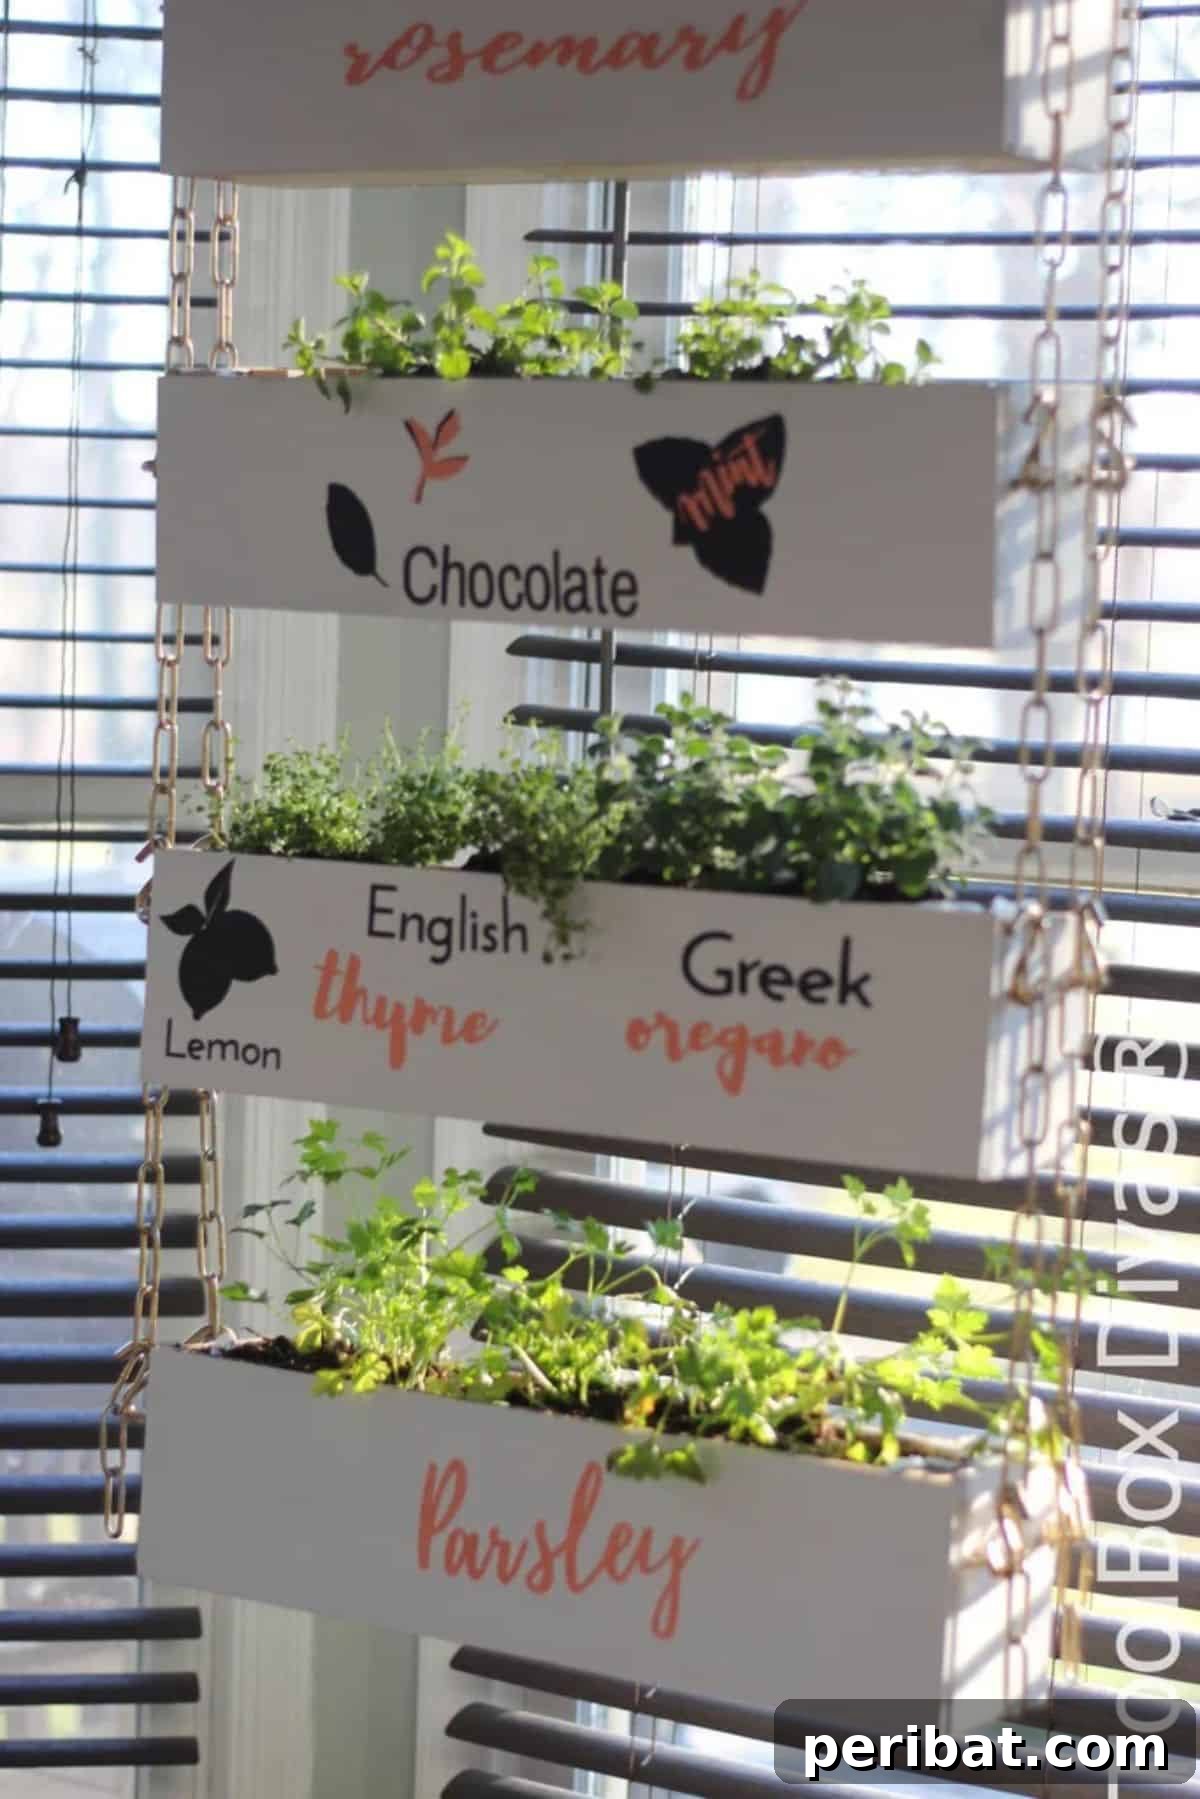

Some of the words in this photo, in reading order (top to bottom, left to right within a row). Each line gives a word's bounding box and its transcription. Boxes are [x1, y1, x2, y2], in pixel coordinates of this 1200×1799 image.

[343, 1, 805, 103] rosemary
[402, 544, 639, 618] Chocolate
[367, 883, 529, 965] English
[312, 948, 498, 1072] thyme
[681, 930, 872, 1009] Greek
[165, 1018, 281, 1071] Lemon
[416, 1457, 703, 1641] Parsley
